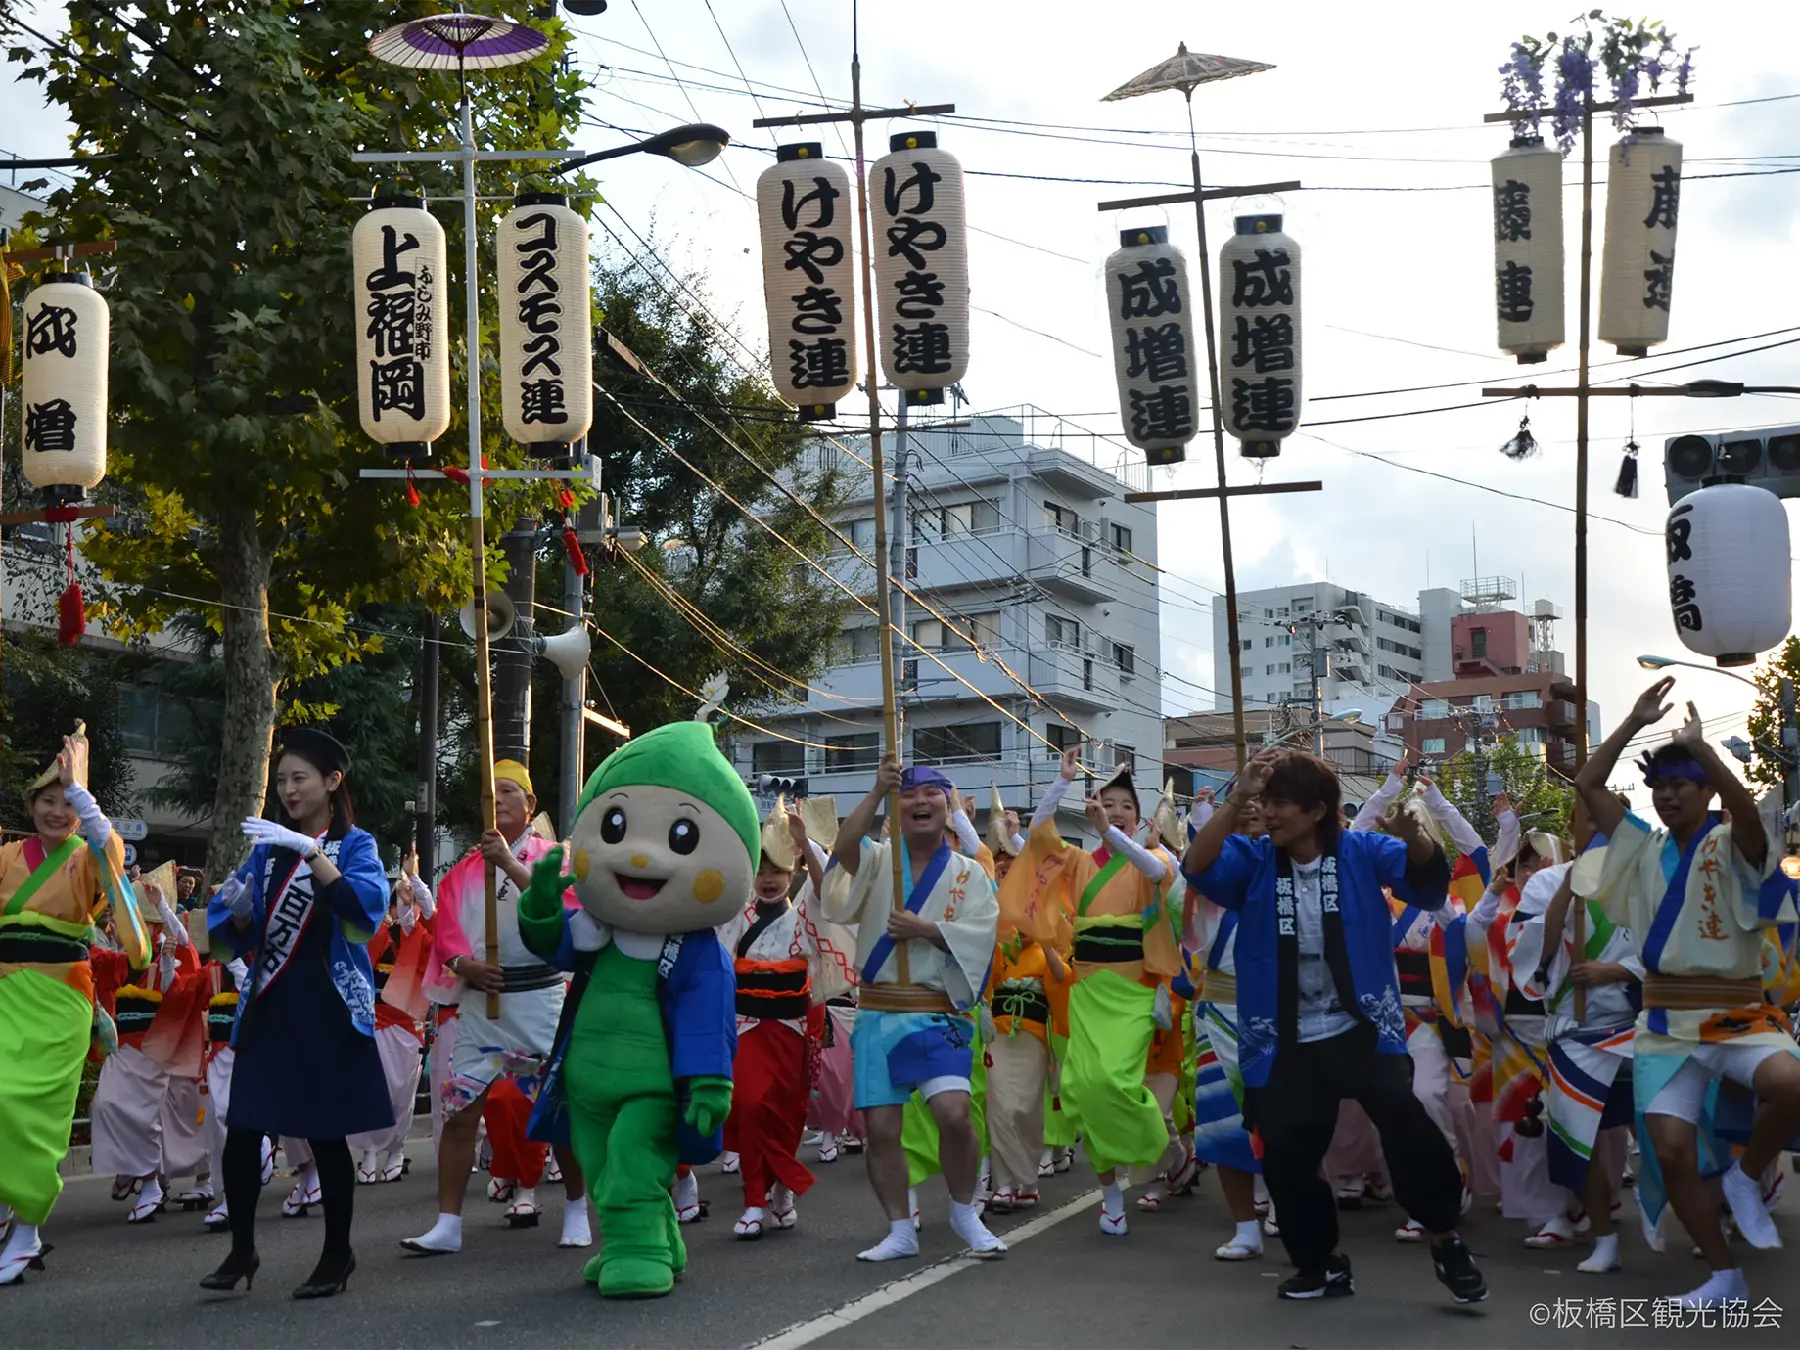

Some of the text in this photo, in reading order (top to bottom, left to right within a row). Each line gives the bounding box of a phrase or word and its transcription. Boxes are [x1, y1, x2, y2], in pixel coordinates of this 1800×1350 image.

[366, 225, 424, 421] 上福岡
[415, 265, 433, 361] ふじみ野市
[515, 212, 568, 425] コスモス連
[781, 176, 850, 389] けやき連
[884, 161, 951, 375] けやき連
[1118, 257, 1193, 442] 成増連
[1230, 248, 1296, 432] 成増連
[25, 302, 77, 452] 成増
